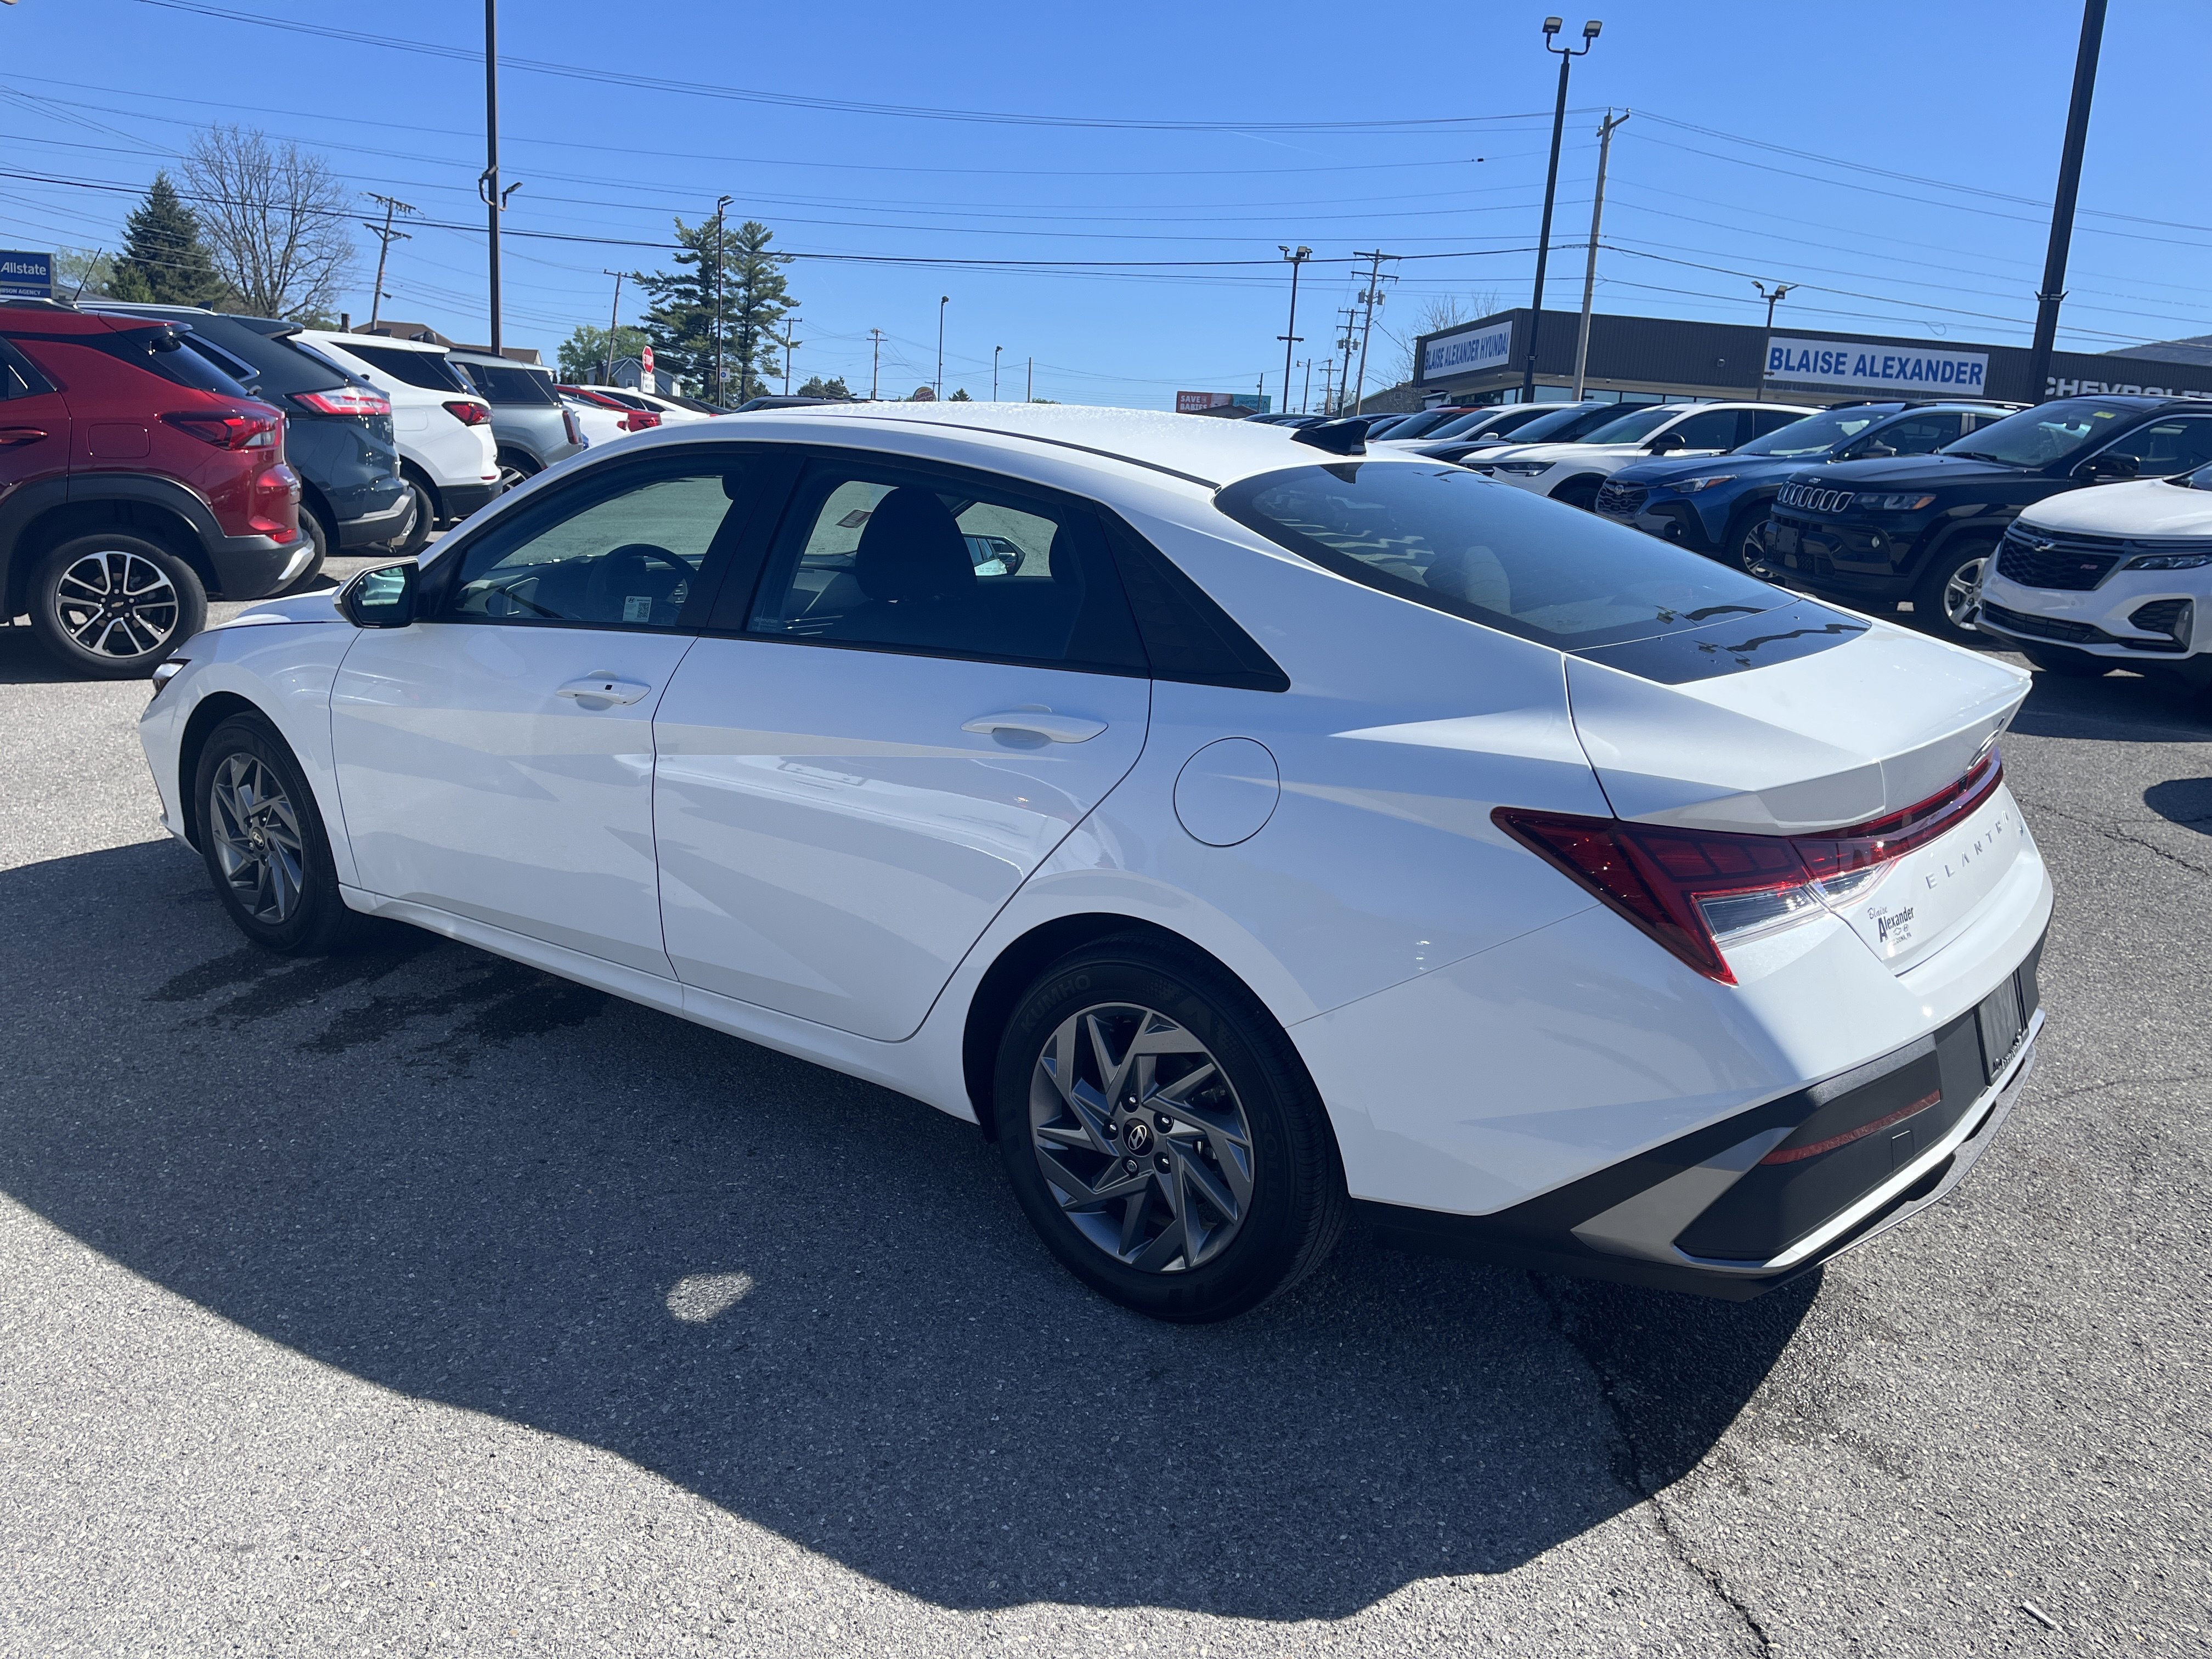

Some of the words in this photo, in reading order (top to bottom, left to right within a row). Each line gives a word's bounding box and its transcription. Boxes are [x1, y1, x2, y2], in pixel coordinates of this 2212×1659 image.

[1, 262, 47, 275] Allstate
[644, 354, 653, 366] STOP
[1425, 347, 1444, 371] BLAISE
[1444, 339, 1480, 367] ALEXANDER
[1480, 331, 1509, 359] HYUNDAI
[1769, 347, 1848, 375] BLAISE
[1852, 354, 1983, 385] ALEXANDER
[1180, 395, 1200, 403] SAVE
[1867, 906, 1888, 919] Blaise
[1878, 906, 1914, 943] Alexander
[1021, 974, 1091, 1033] KUMHO
